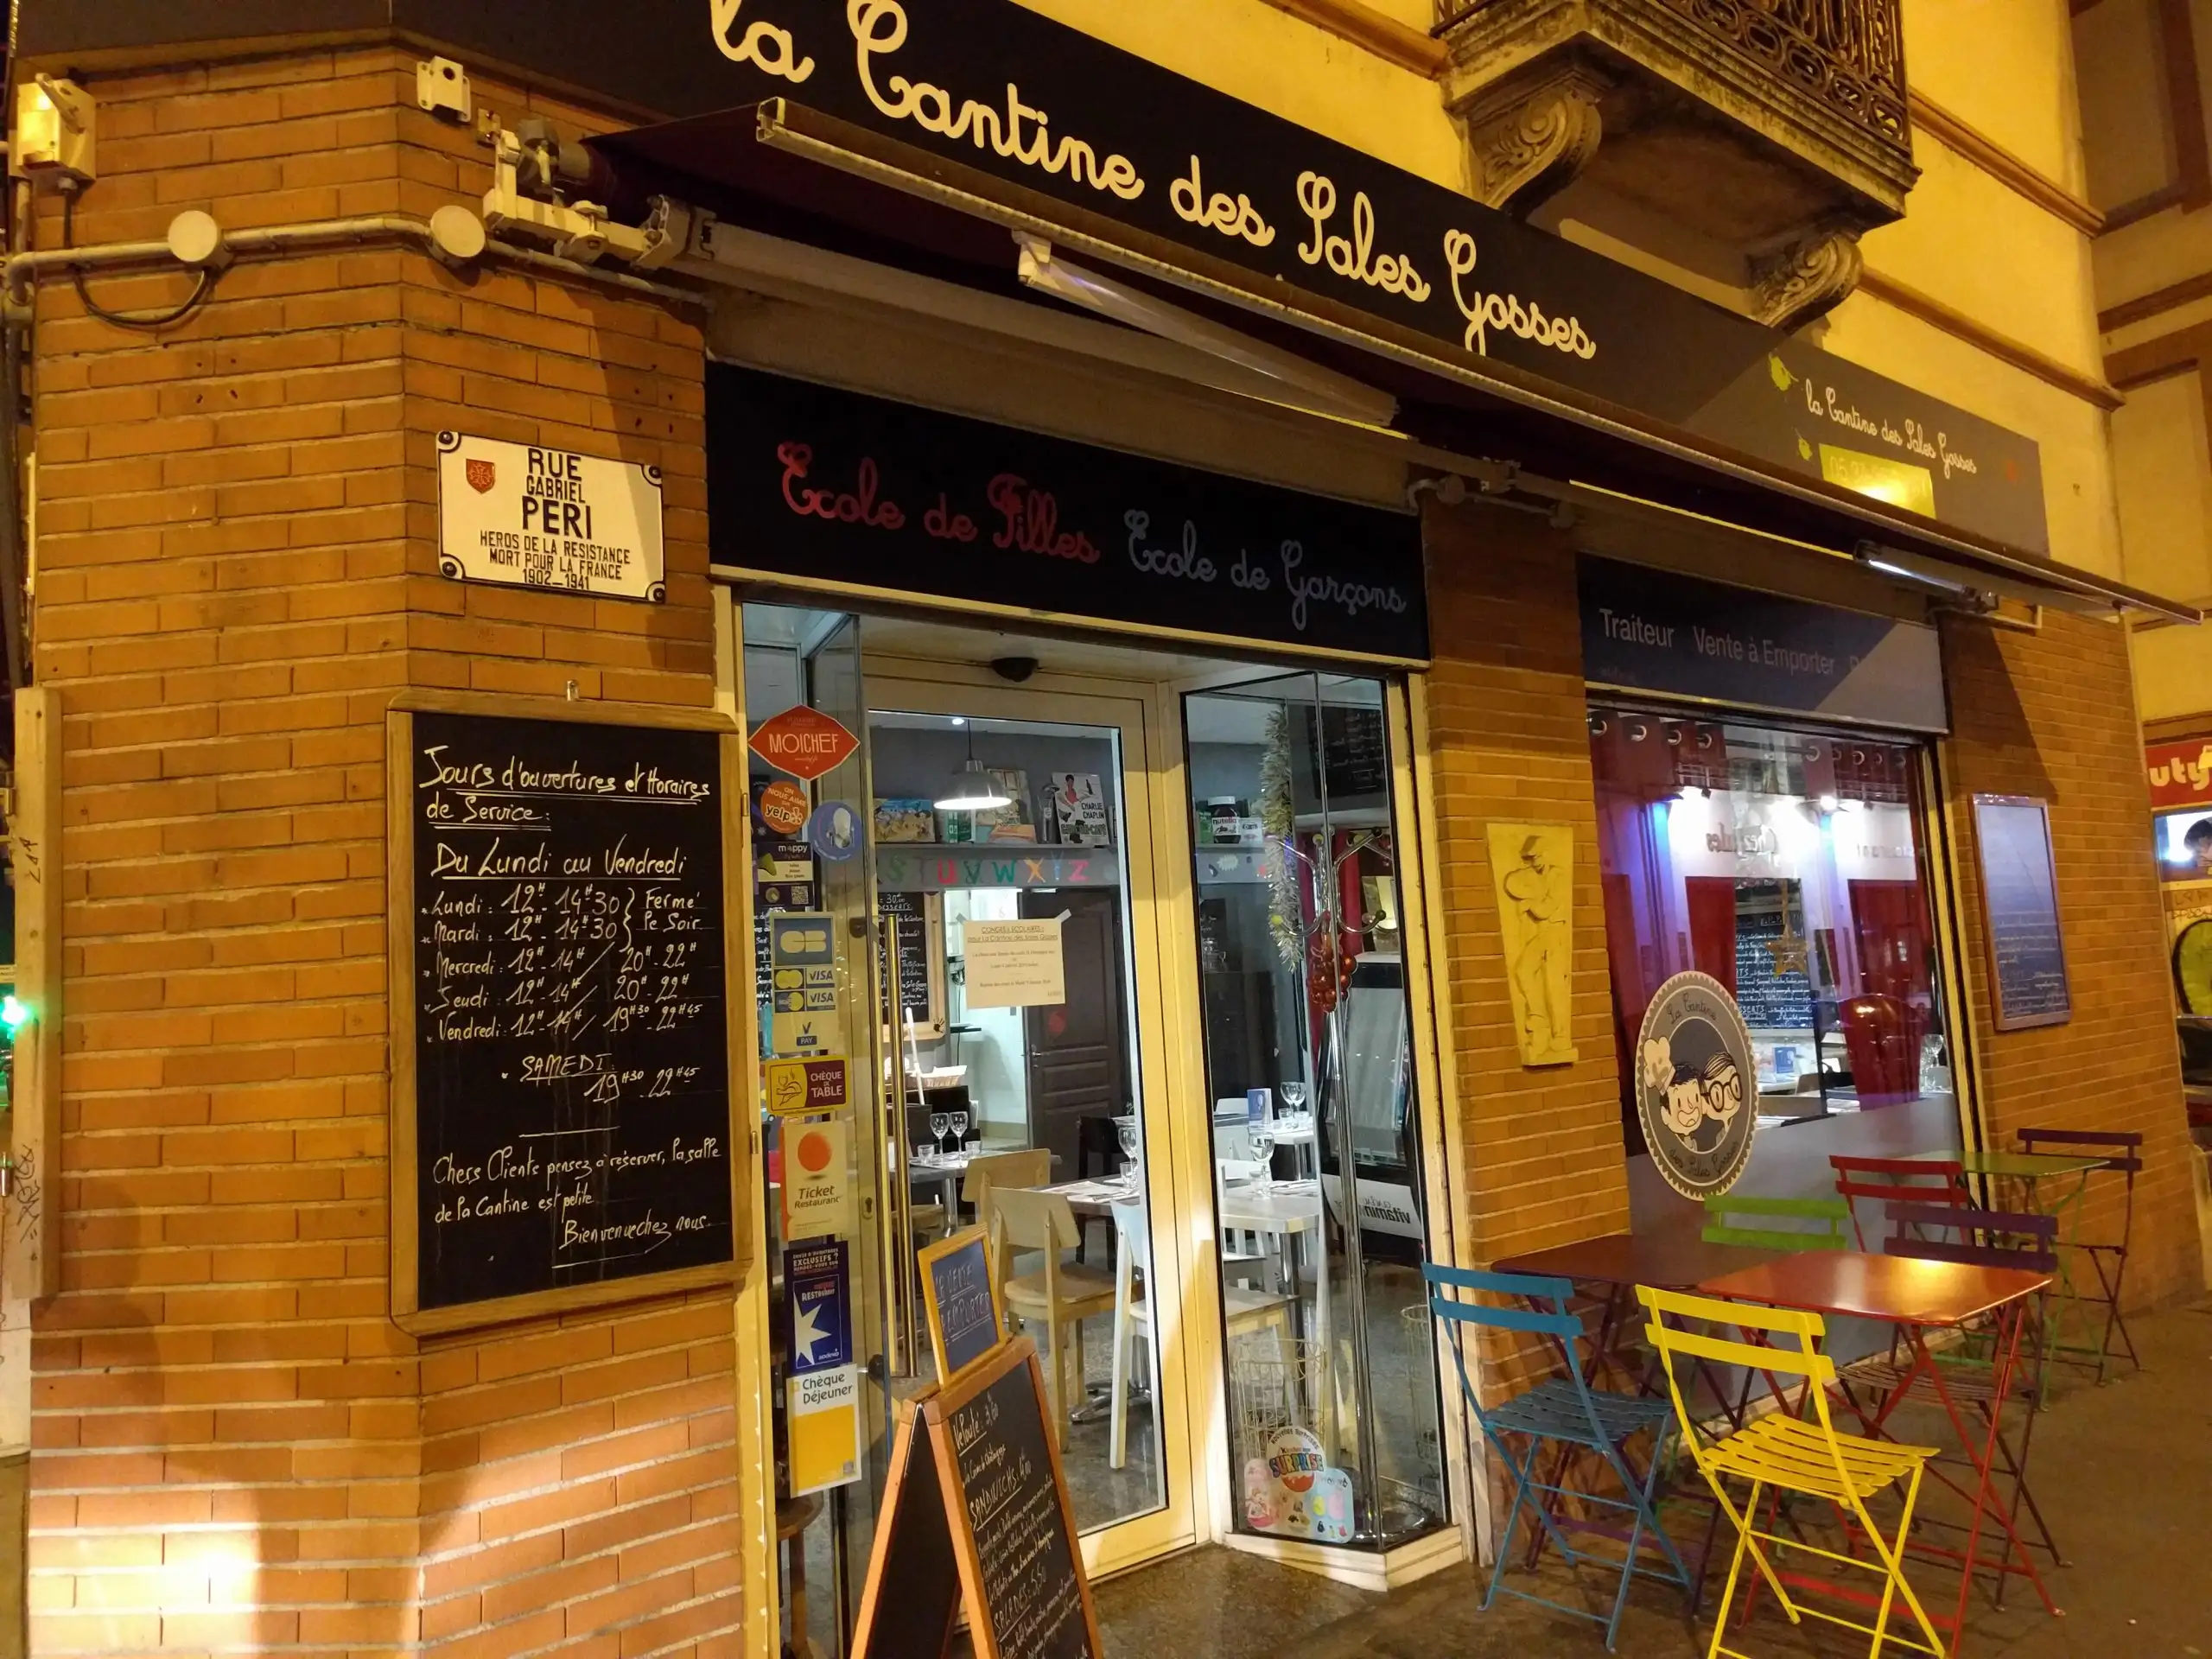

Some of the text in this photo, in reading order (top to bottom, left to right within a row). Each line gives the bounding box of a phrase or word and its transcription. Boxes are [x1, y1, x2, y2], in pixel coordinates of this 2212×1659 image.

[847, 0, 1145, 200] Cantine
[1169, 154, 1275, 247] des
[1444, 228, 1597, 360] Gosses
[1826, 385, 1878, 436] Cantine
[1880, 418, 1903, 447] des
[1937, 431, 1977, 480] Gosses
[527, 448, 582, 481] RUE
[526, 475, 586, 504] GABRIEL
[778, 441, 1101, 563] Ecole de Filles
[522, 495, 592, 539] PERI
[480, 530, 631, 564] HEROS DE LA RESISTANCE
[489, 548, 622, 580] MORT POUR LA FRANCE
[1124, 508, 1408, 632] Ecole de Garçons
[1599, 608, 1675, 649] Traiteur
[1694, 626, 1743, 661] Vente
[1749, 636, 1759, 664] à
[1763, 639, 1835, 677] Emporter
[768, 733, 839, 753] MOICHEF
[419, 745, 495, 789] Jours
[501, 755, 616, 794] d'ouvertures
[767, 786, 807, 808] NOUS AIME
[785, 786, 794, 796] ON
[427, 790, 455, 819] de
[765, 804, 792, 823] yelp
[1081, 802, 1103, 810] CHARLIE
[1083, 810, 1105, 819] CHAPLIN
[1212, 817, 1237, 825] nutella
[430, 834, 687, 877] Du Lundi au Vendredi
[887, 851, 907, 884] S
[938, 859, 957, 885] U
[963, 859, 981, 883] V
[993, 859, 1018, 884] W
[1023, 856, 1046, 884] X
[1068, 860, 1090, 883] Z
[645, 887, 701, 910] Fermé
[780, 930, 827, 954] CB
[810, 969, 833, 982] VISA
[810, 992, 834, 1003] VISA
[1682, 991, 1718, 1020] Cantine
[802, 1021, 812, 1034] V
[810, 1071, 842, 1082] CHÈQUE
[810, 1085, 842, 1098] TABLE
[433, 1151, 481, 1185] Chers
[487, 1146, 539, 1180] Clients
[547, 1156, 594, 1192] pensez
[671, 1137, 684, 1161] la
[686, 1137, 722, 1165] salle
[435, 1181, 594, 1224] de la Cantine est petite
[794, 1195, 840, 1210] Restaurant
[798, 1185, 836, 1200] Ticket
[793, 1255, 831, 1267] EXCLUSIFS
[802, 1371, 845, 1392] Chèque
[803, 1383, 854, 1405] Déjeuner
[1268, 1452, 1325, 1478] SURPRISE
